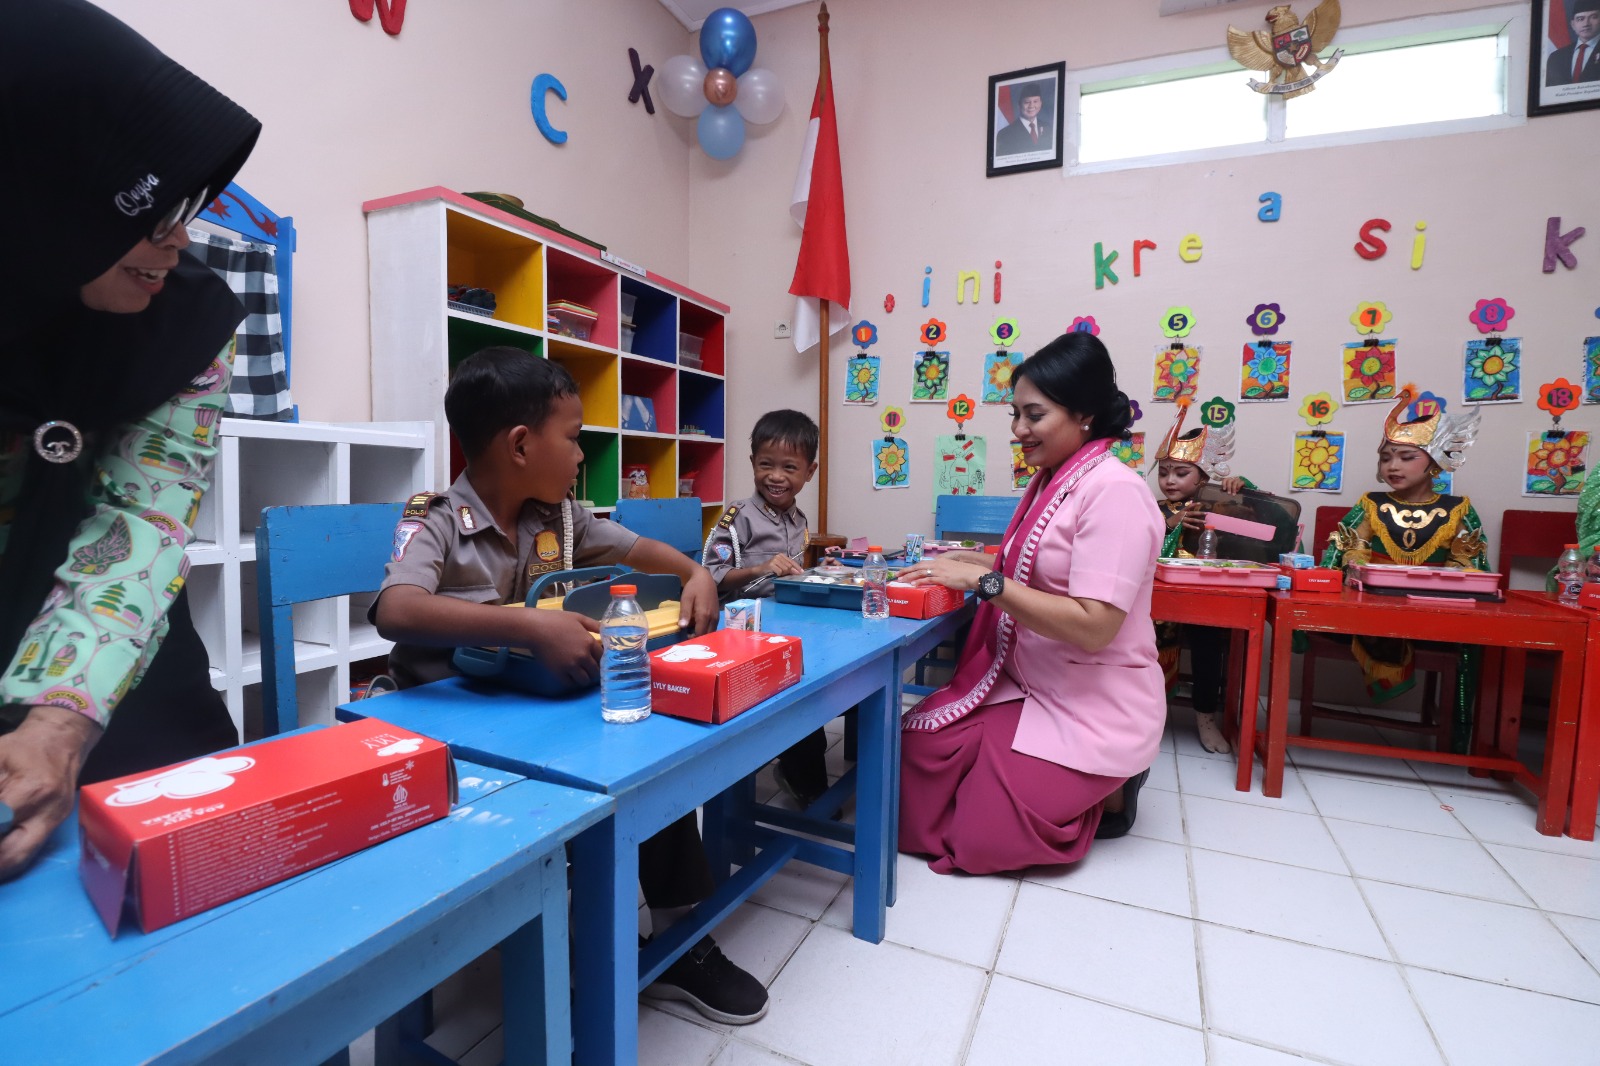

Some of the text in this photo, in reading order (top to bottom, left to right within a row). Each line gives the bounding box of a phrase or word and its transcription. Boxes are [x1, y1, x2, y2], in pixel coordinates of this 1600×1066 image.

[1260, 311, 1272, 326] 6
[1367, 309, 1377, 325] 7
[1485, 306, 1499, 322] 8
[1173, 315, 1185, 330] 5
[860, 328, 866, 341] 1
[928, 325, 938, 338] 2
[1000, 325, 1010, 338] 3
[1548, 388, 1571, 407] 18
[954, 401, 969, 415] 12
[1208, 406, 1227, 421] 15
[1309, 401, 1329, 417] 16
[1417, 401, 1437, 418] 17
[887, 412, 898, 427] 11
[653, 681, 691, 695] LYLY BAKERY
